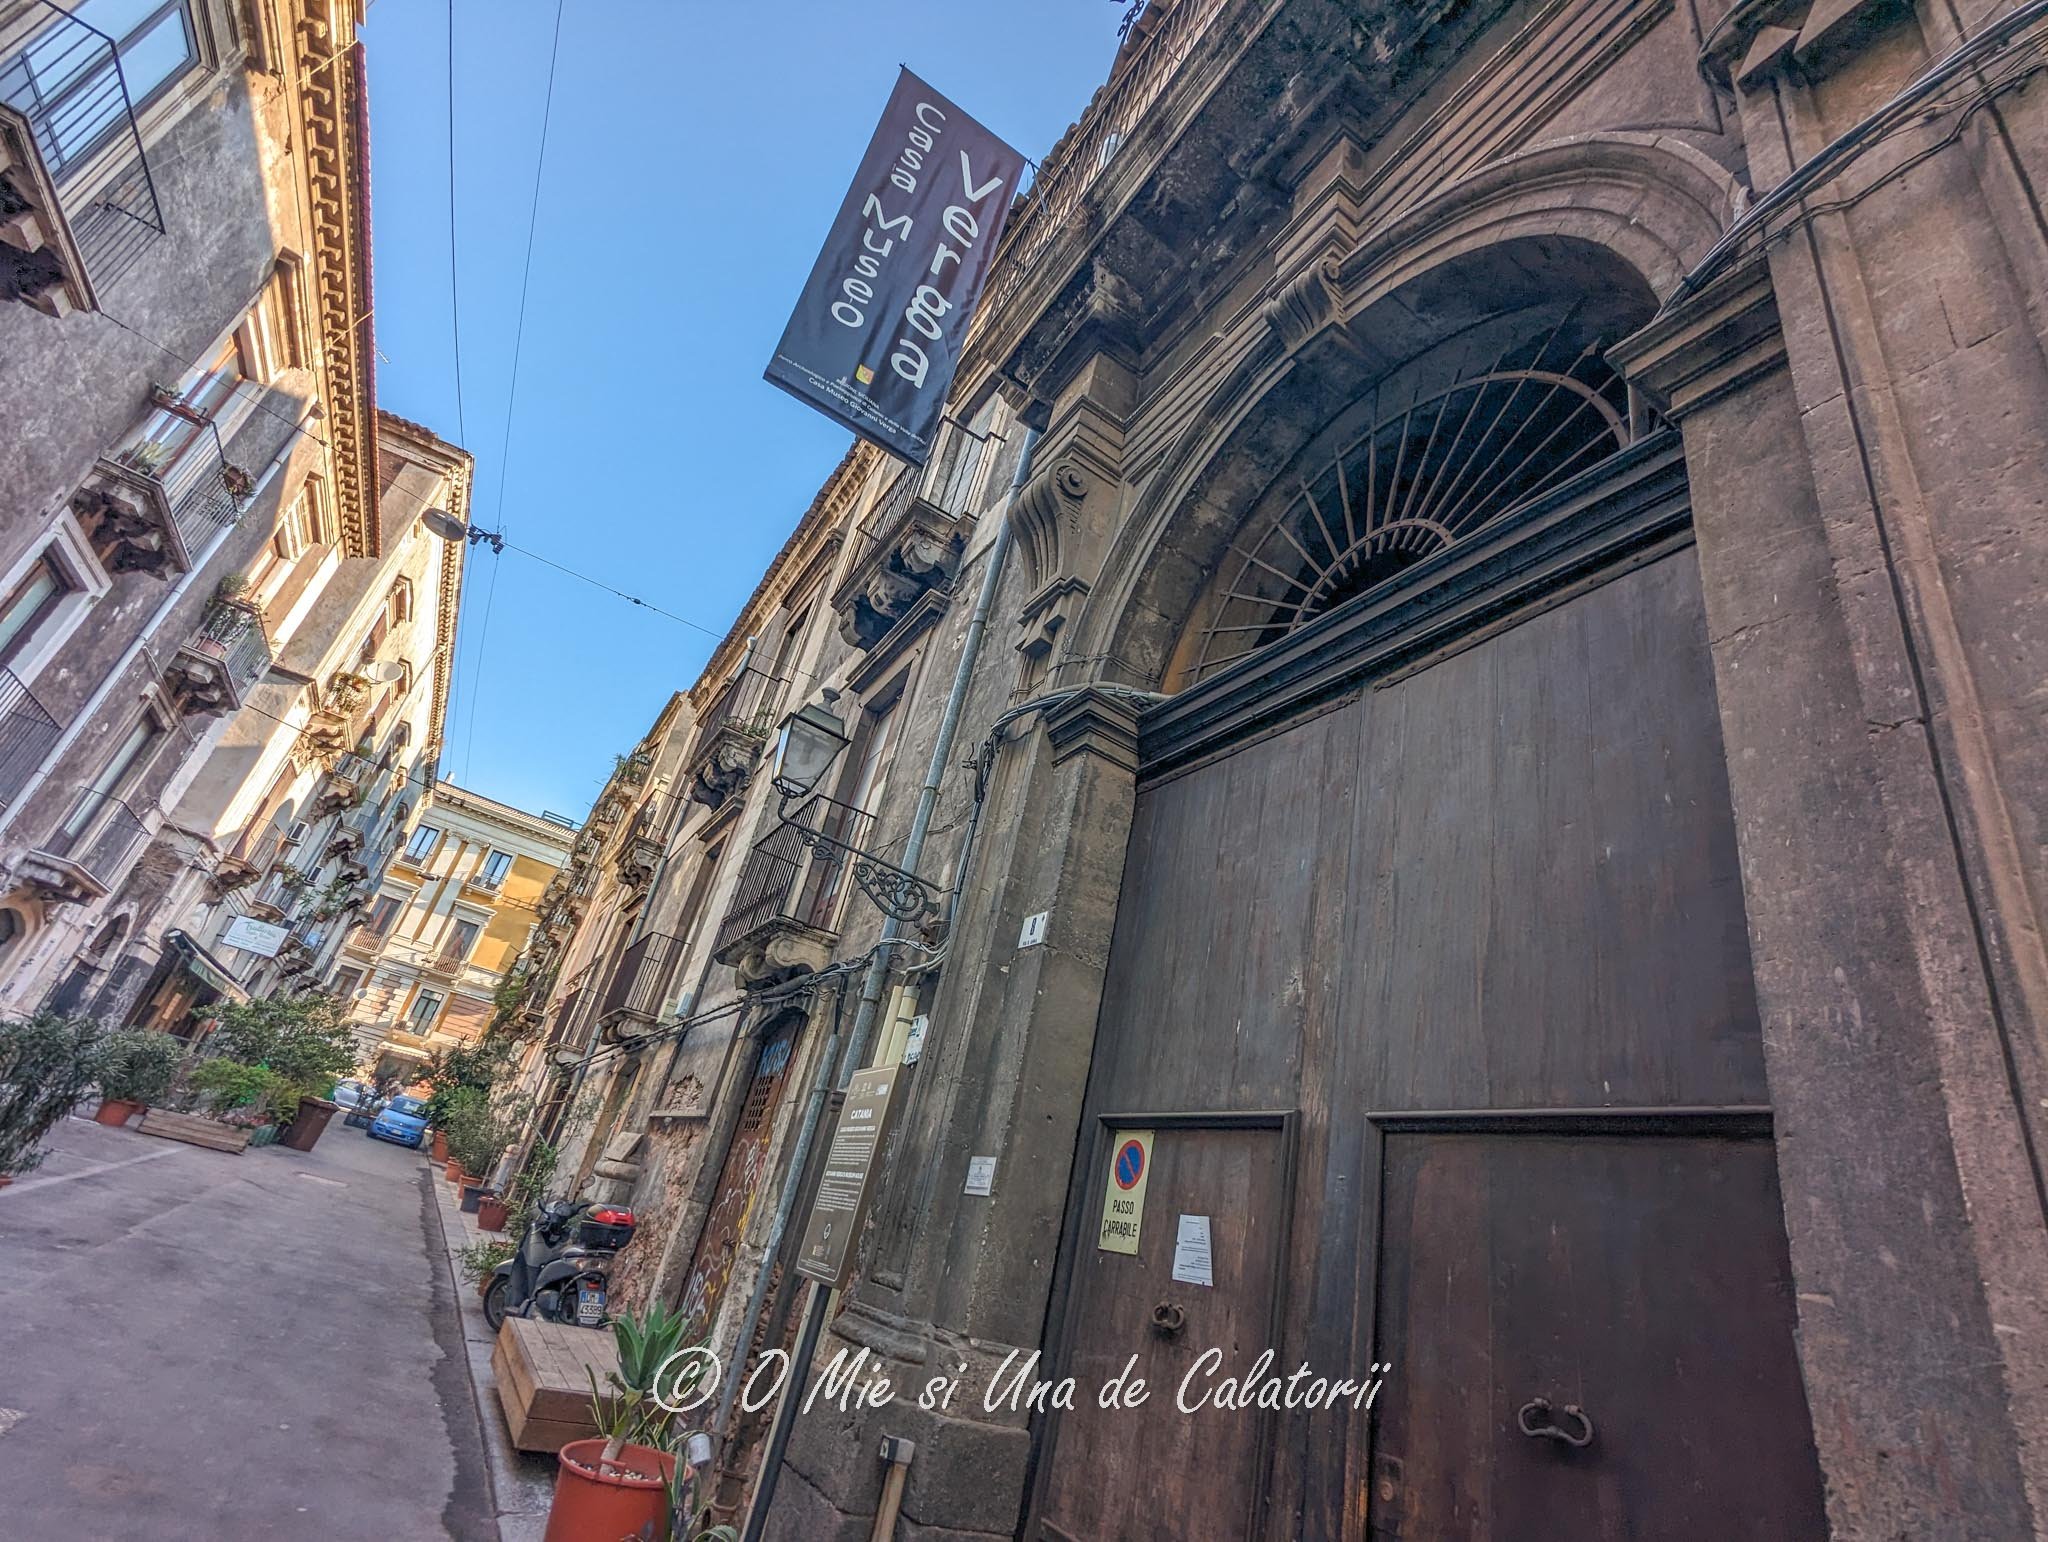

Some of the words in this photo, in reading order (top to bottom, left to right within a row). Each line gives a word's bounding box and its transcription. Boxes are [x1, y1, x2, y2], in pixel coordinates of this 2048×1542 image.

[890, 102, 946, 194] Casa
[831, 193, 914, 328] Museo
[890, 150, 1003, 388] Verga
[809, 377, 825, 390] Casa
[826, 387, 849, 404] Museo
[849, 401, 878, 422] Giovanni
[878, 419, 897, 434] Verga
[1103, 1219, 1138, 1238] CARRABILE
[1112, 1199, 1135, 1215] PASSO
